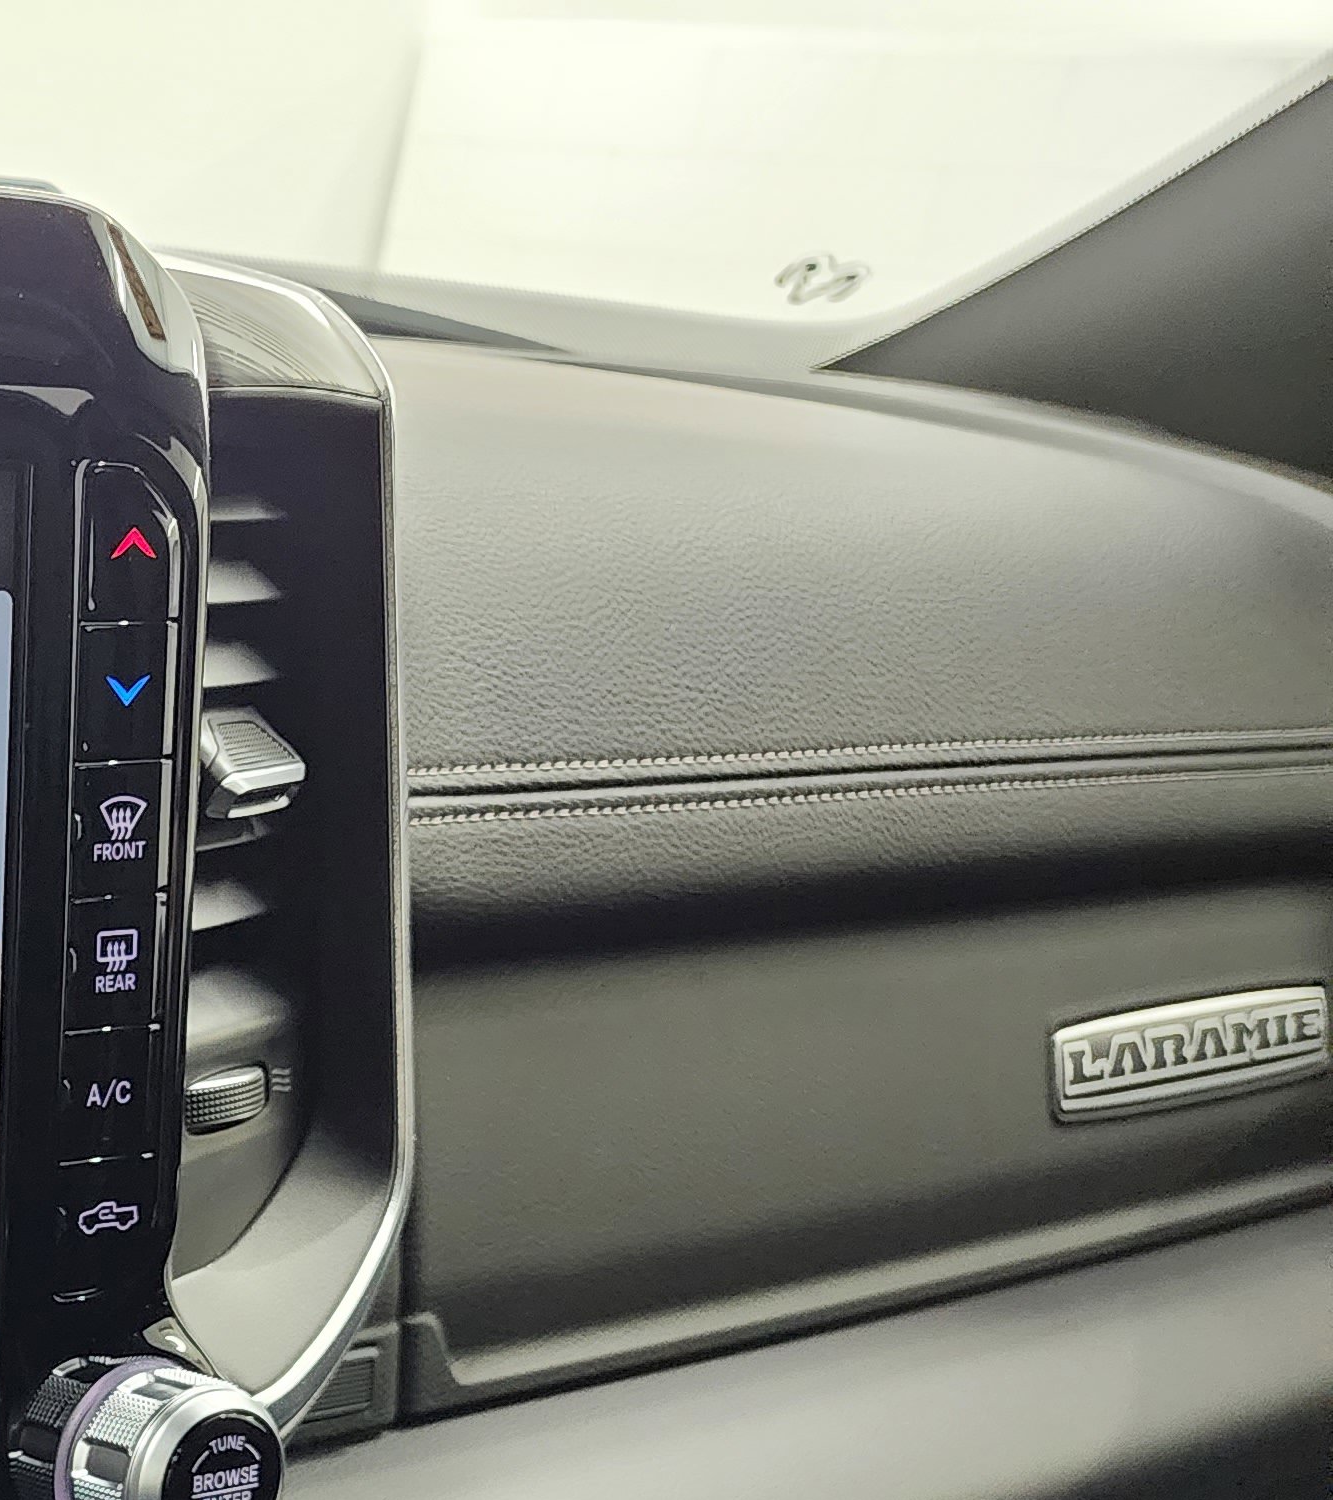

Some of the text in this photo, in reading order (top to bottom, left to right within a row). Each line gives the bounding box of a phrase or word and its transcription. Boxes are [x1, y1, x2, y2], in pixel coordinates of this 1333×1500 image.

[93, 840, 146, 862] FRONT
[95, 973, 136, 993] REAR
[1068, 1008, 1322, 1086] LARAMIE
[86, 1079, 131, 1107] A/C
[209, 1434, 246, 1454] TUNE
[193, 1464, 259, 1493] BROWSE
